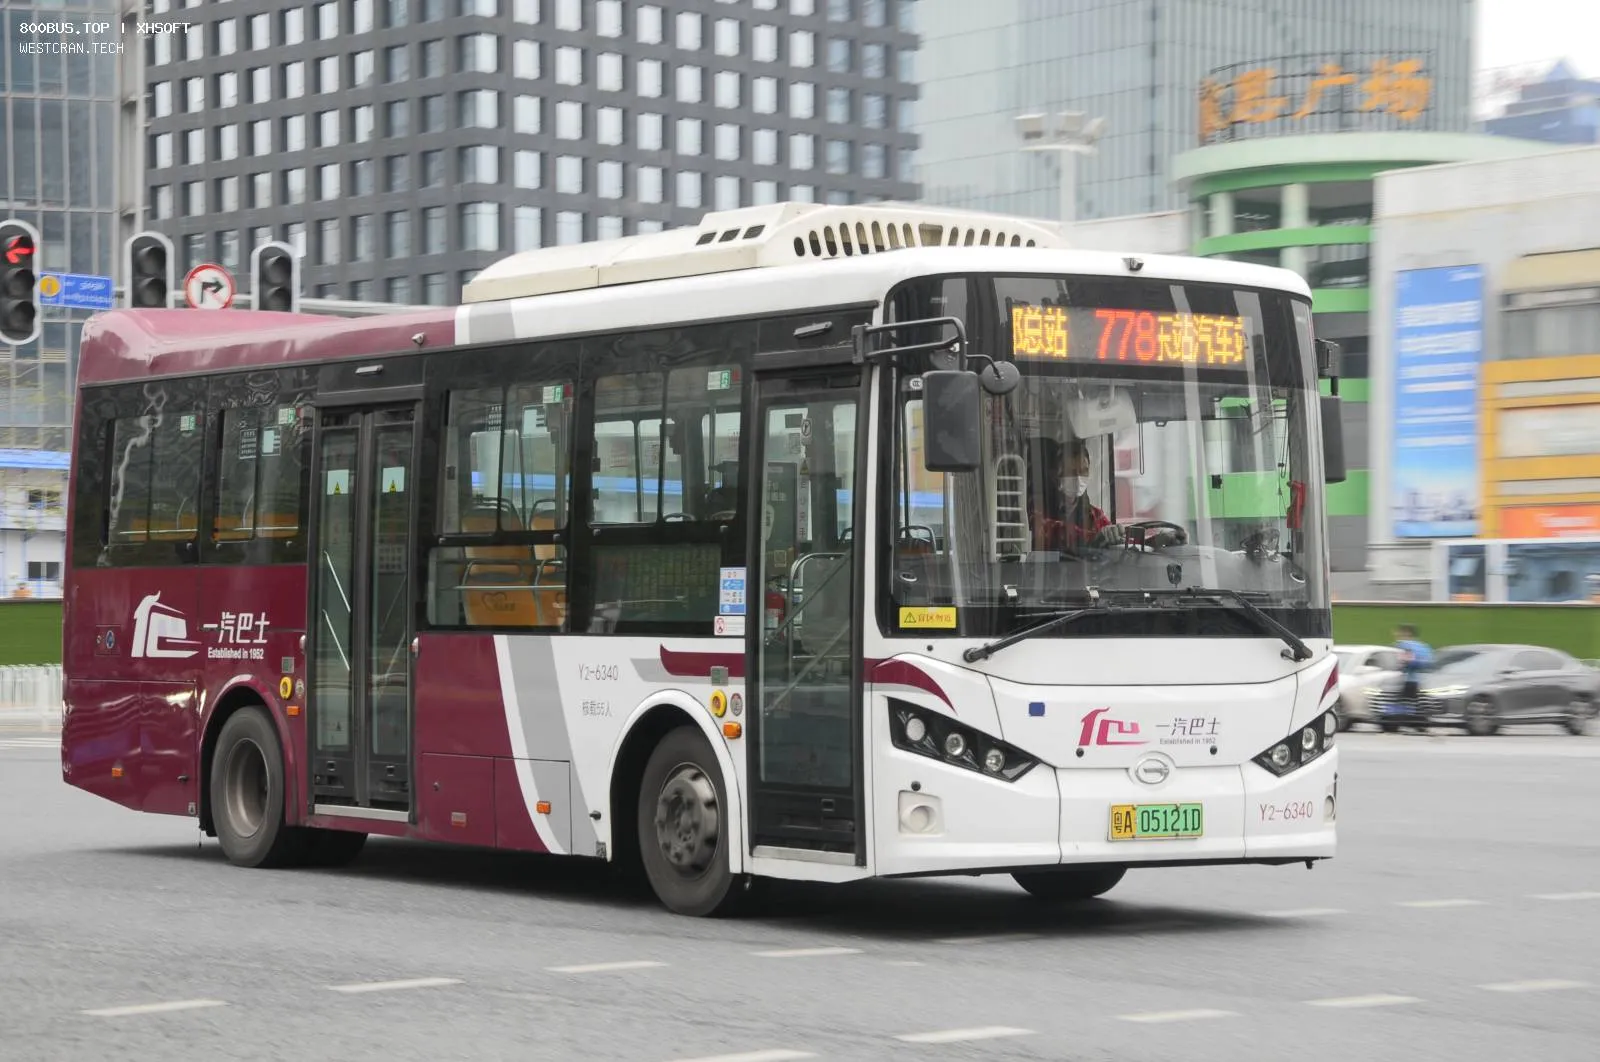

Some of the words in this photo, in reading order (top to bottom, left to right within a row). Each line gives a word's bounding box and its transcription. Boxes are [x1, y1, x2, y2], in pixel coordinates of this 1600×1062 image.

[1096, 308, 1158, 361] 778
[203, 611, 270, 644] 一汽巴士
[207, 646, 242, 659] Established
[242, 647, 249, 659] in
[578, 663, 619, 681] Y2-6340
[1155, 716, 1221, 736] 一汽巴士
[1159, 737, 1194, 745] Established
[1194, 737, 1201, 745] in
[1141, 808, 1200, 833] 05121D
[1259, 801, 1314, 821] Y2-6340
